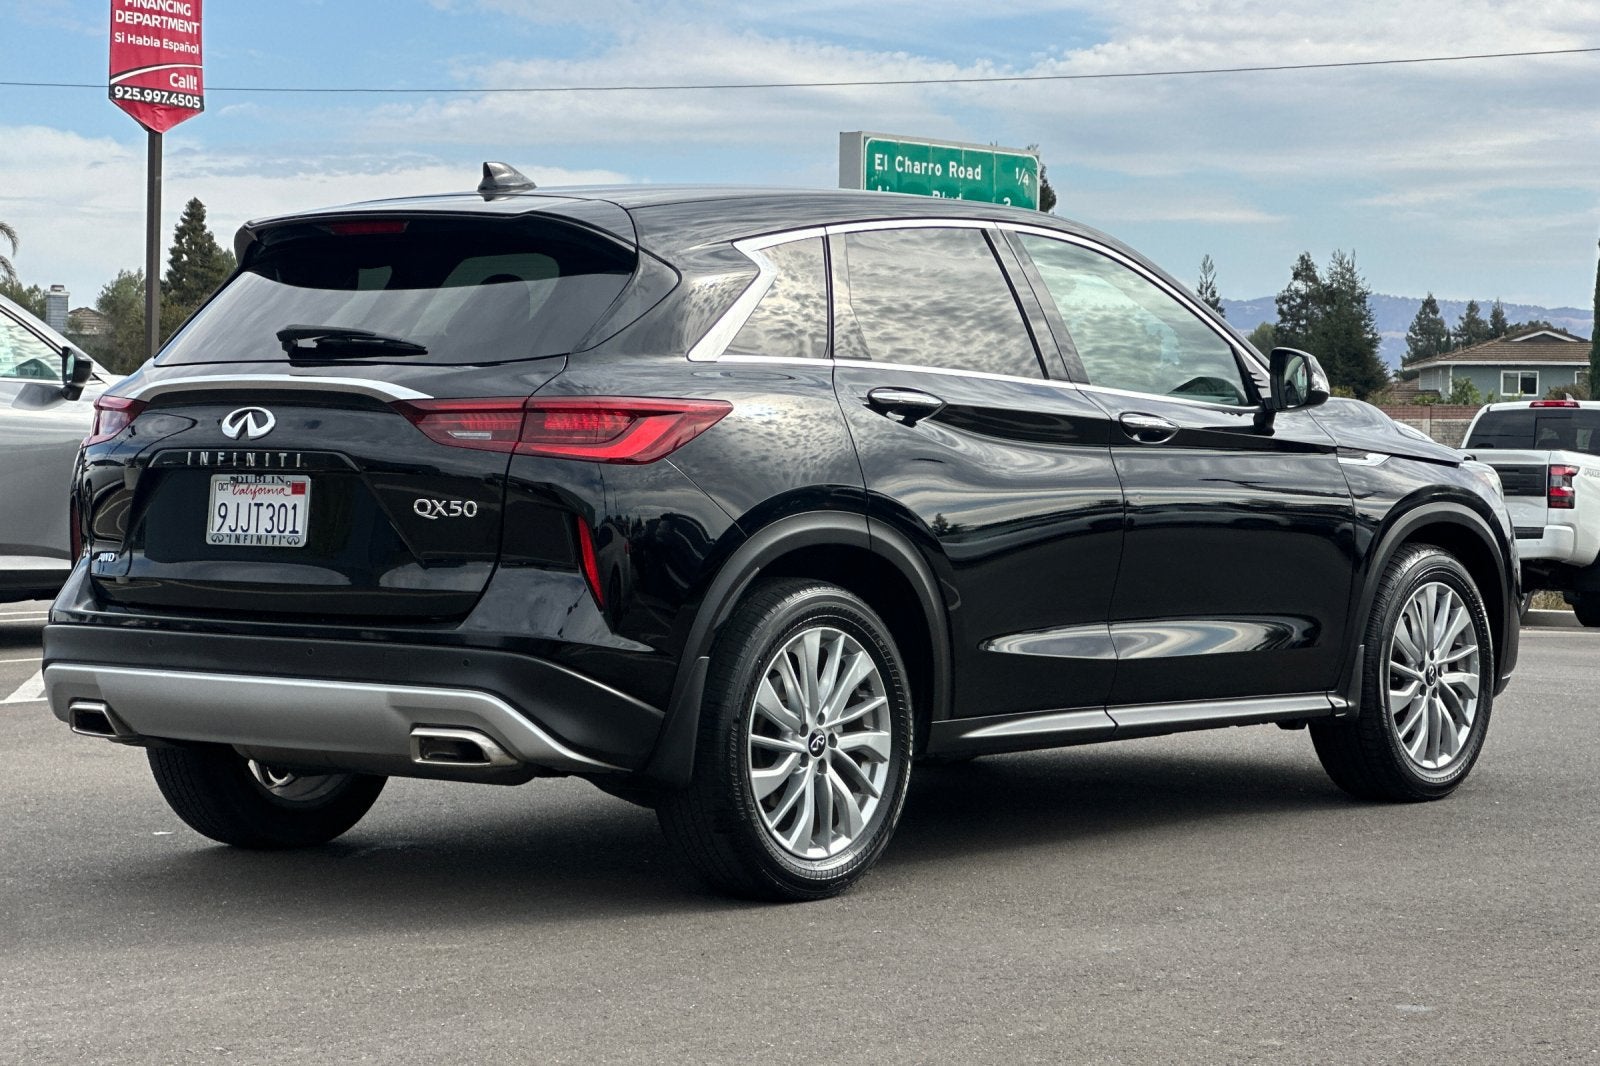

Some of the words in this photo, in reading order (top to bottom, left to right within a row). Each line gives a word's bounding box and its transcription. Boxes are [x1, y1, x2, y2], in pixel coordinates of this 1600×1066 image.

[125, 0, 191, 17] FINANCING
[115, 10, 200, 34] DEPARTMENT
[115, 32, 125, 43] Si
[127, 34, 161, 48] Habla
[162, 39, 199, 54] Español
[169, 73, 197, 90] Call!
[114, 86, 201, 108] 925.997.4505
[874, 153, 888, 171] El
[895, 156, 942, 176] Charro
[949, 161, 982, 180] Road
[187, 451, 301, 468] INFINITI
[218, 482, 230, 491] OCT
[236, 475, 285, 484] DUBLIN
[232, 483, 291, 500] California
[413, 498, 478, 519] QX50
[217, 502, 299, 534] 9JJT301
[228, 534, 283, 545] INFINITI
